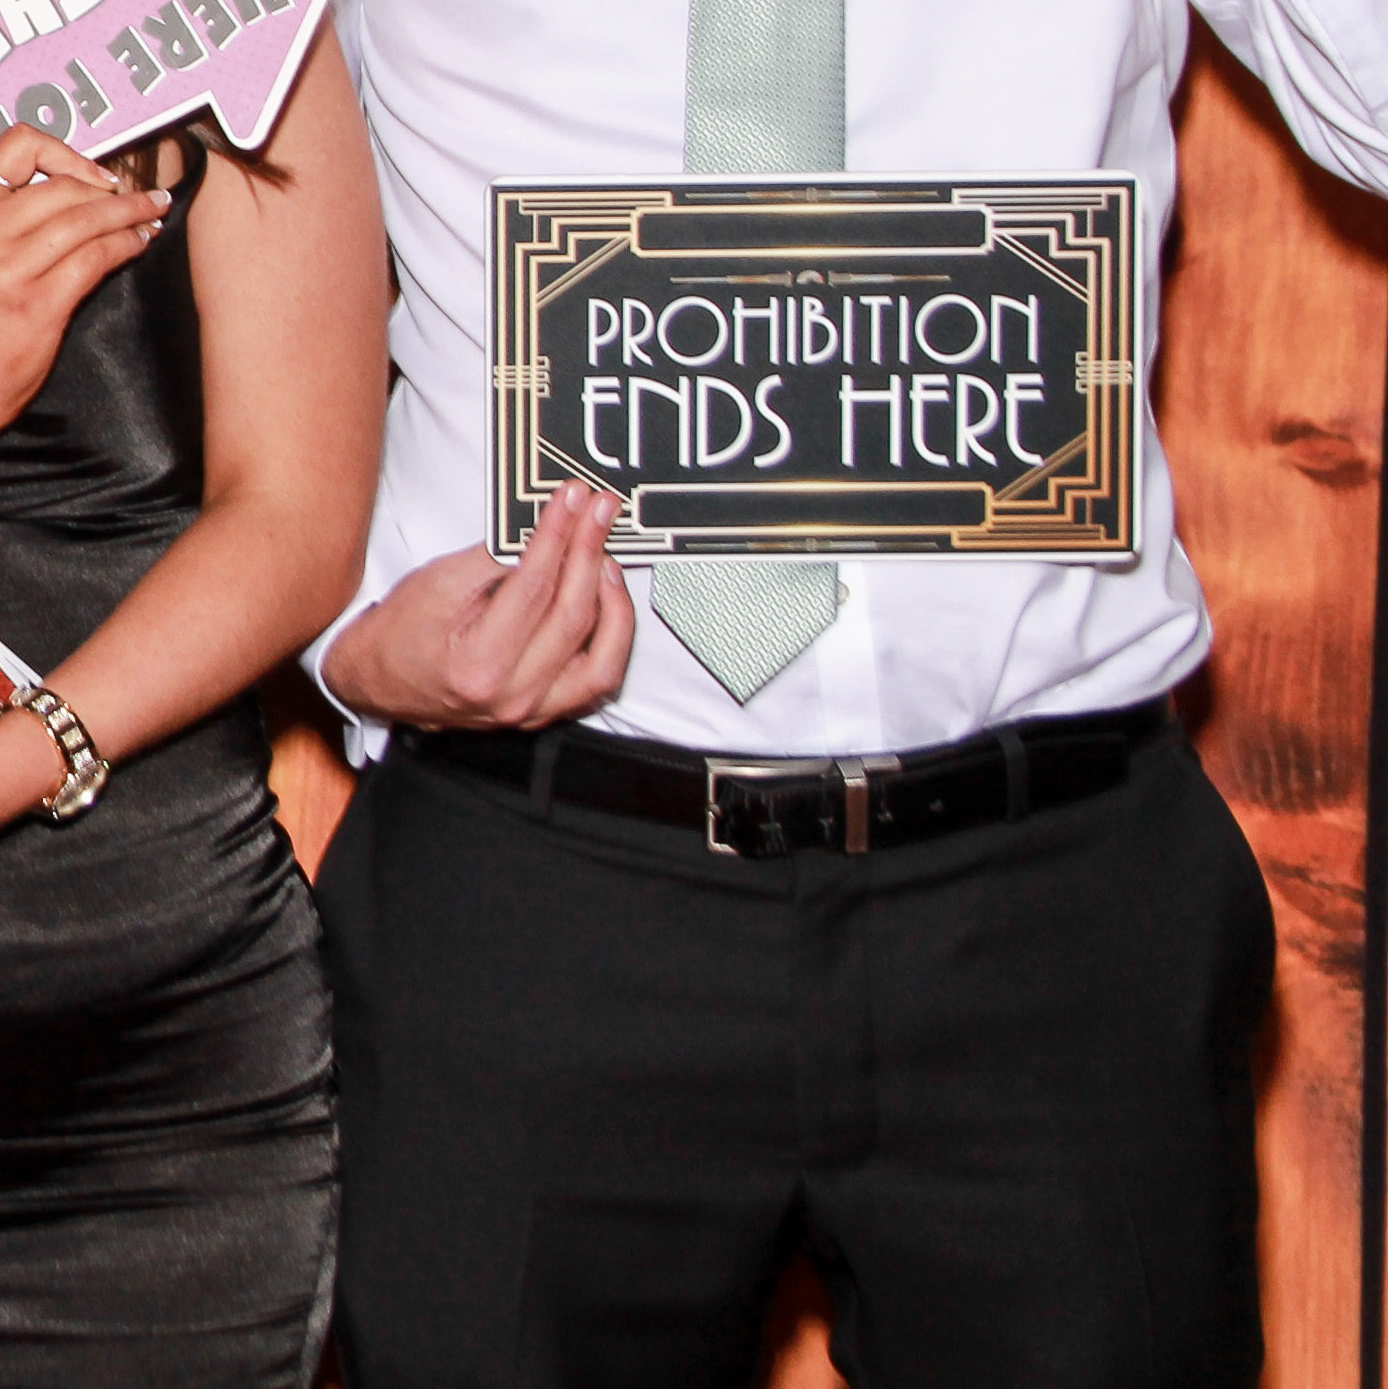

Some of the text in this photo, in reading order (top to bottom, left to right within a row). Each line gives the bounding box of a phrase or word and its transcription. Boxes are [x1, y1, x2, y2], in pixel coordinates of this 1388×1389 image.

[587, 293, 1040, 366] PROHIBITION
[581, 373, 1045, 468] ENDS HERE
